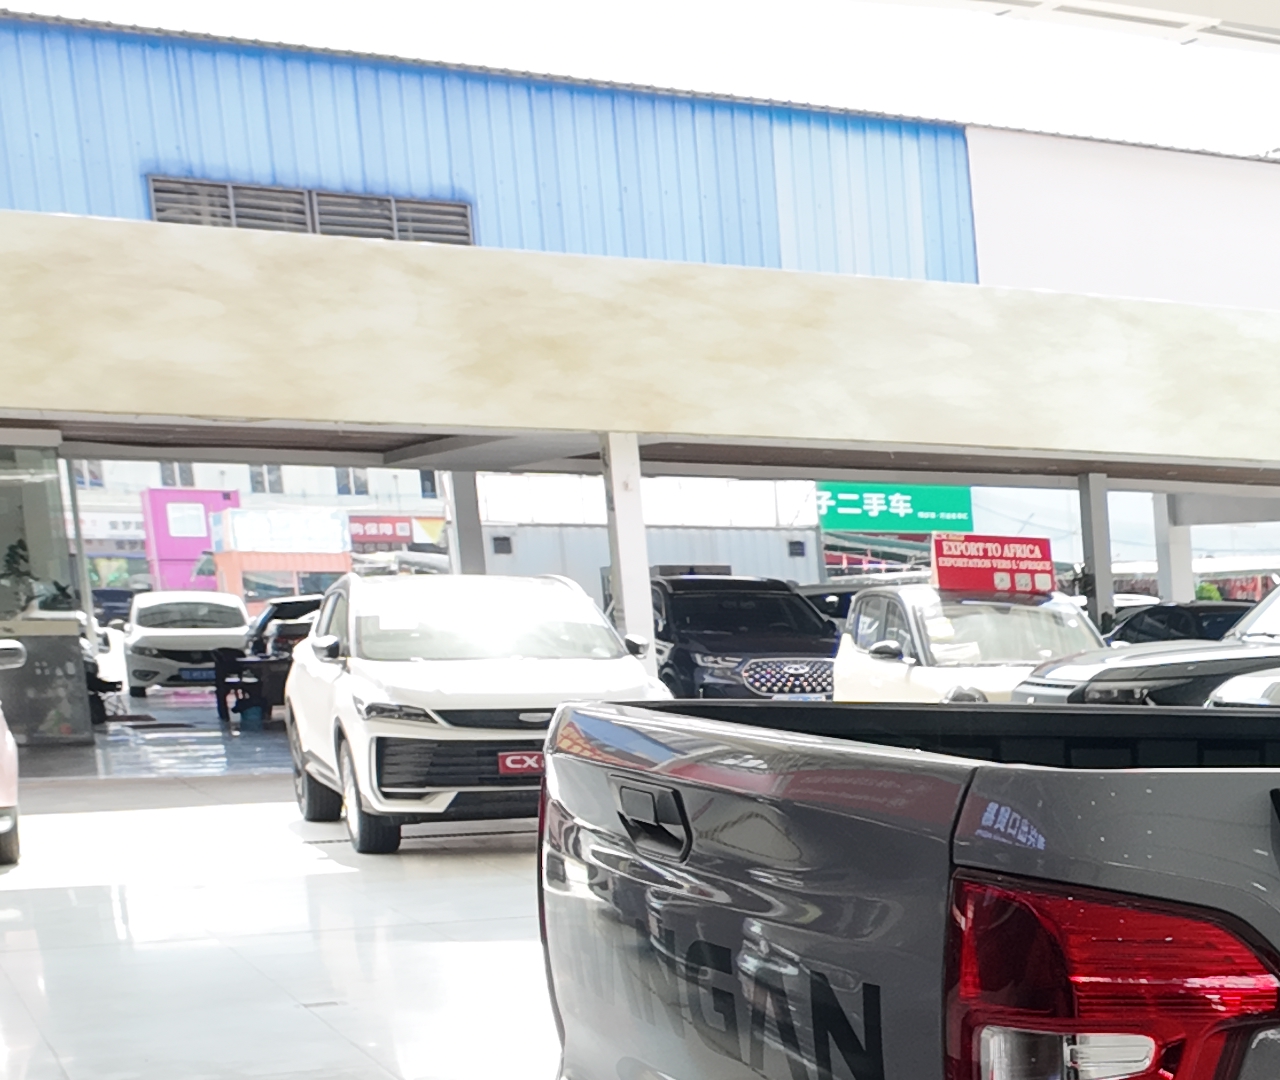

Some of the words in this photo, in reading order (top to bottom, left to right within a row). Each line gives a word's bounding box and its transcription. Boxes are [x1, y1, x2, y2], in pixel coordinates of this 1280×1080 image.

[816, 490, 913, 517] 子二手车
[942, 541, 986, 556] EXPORT
[985, 543, 1001, 557] TO
[1003, 544, 1042, 559] AFRICA
[505, 755, 539, 769] CX
